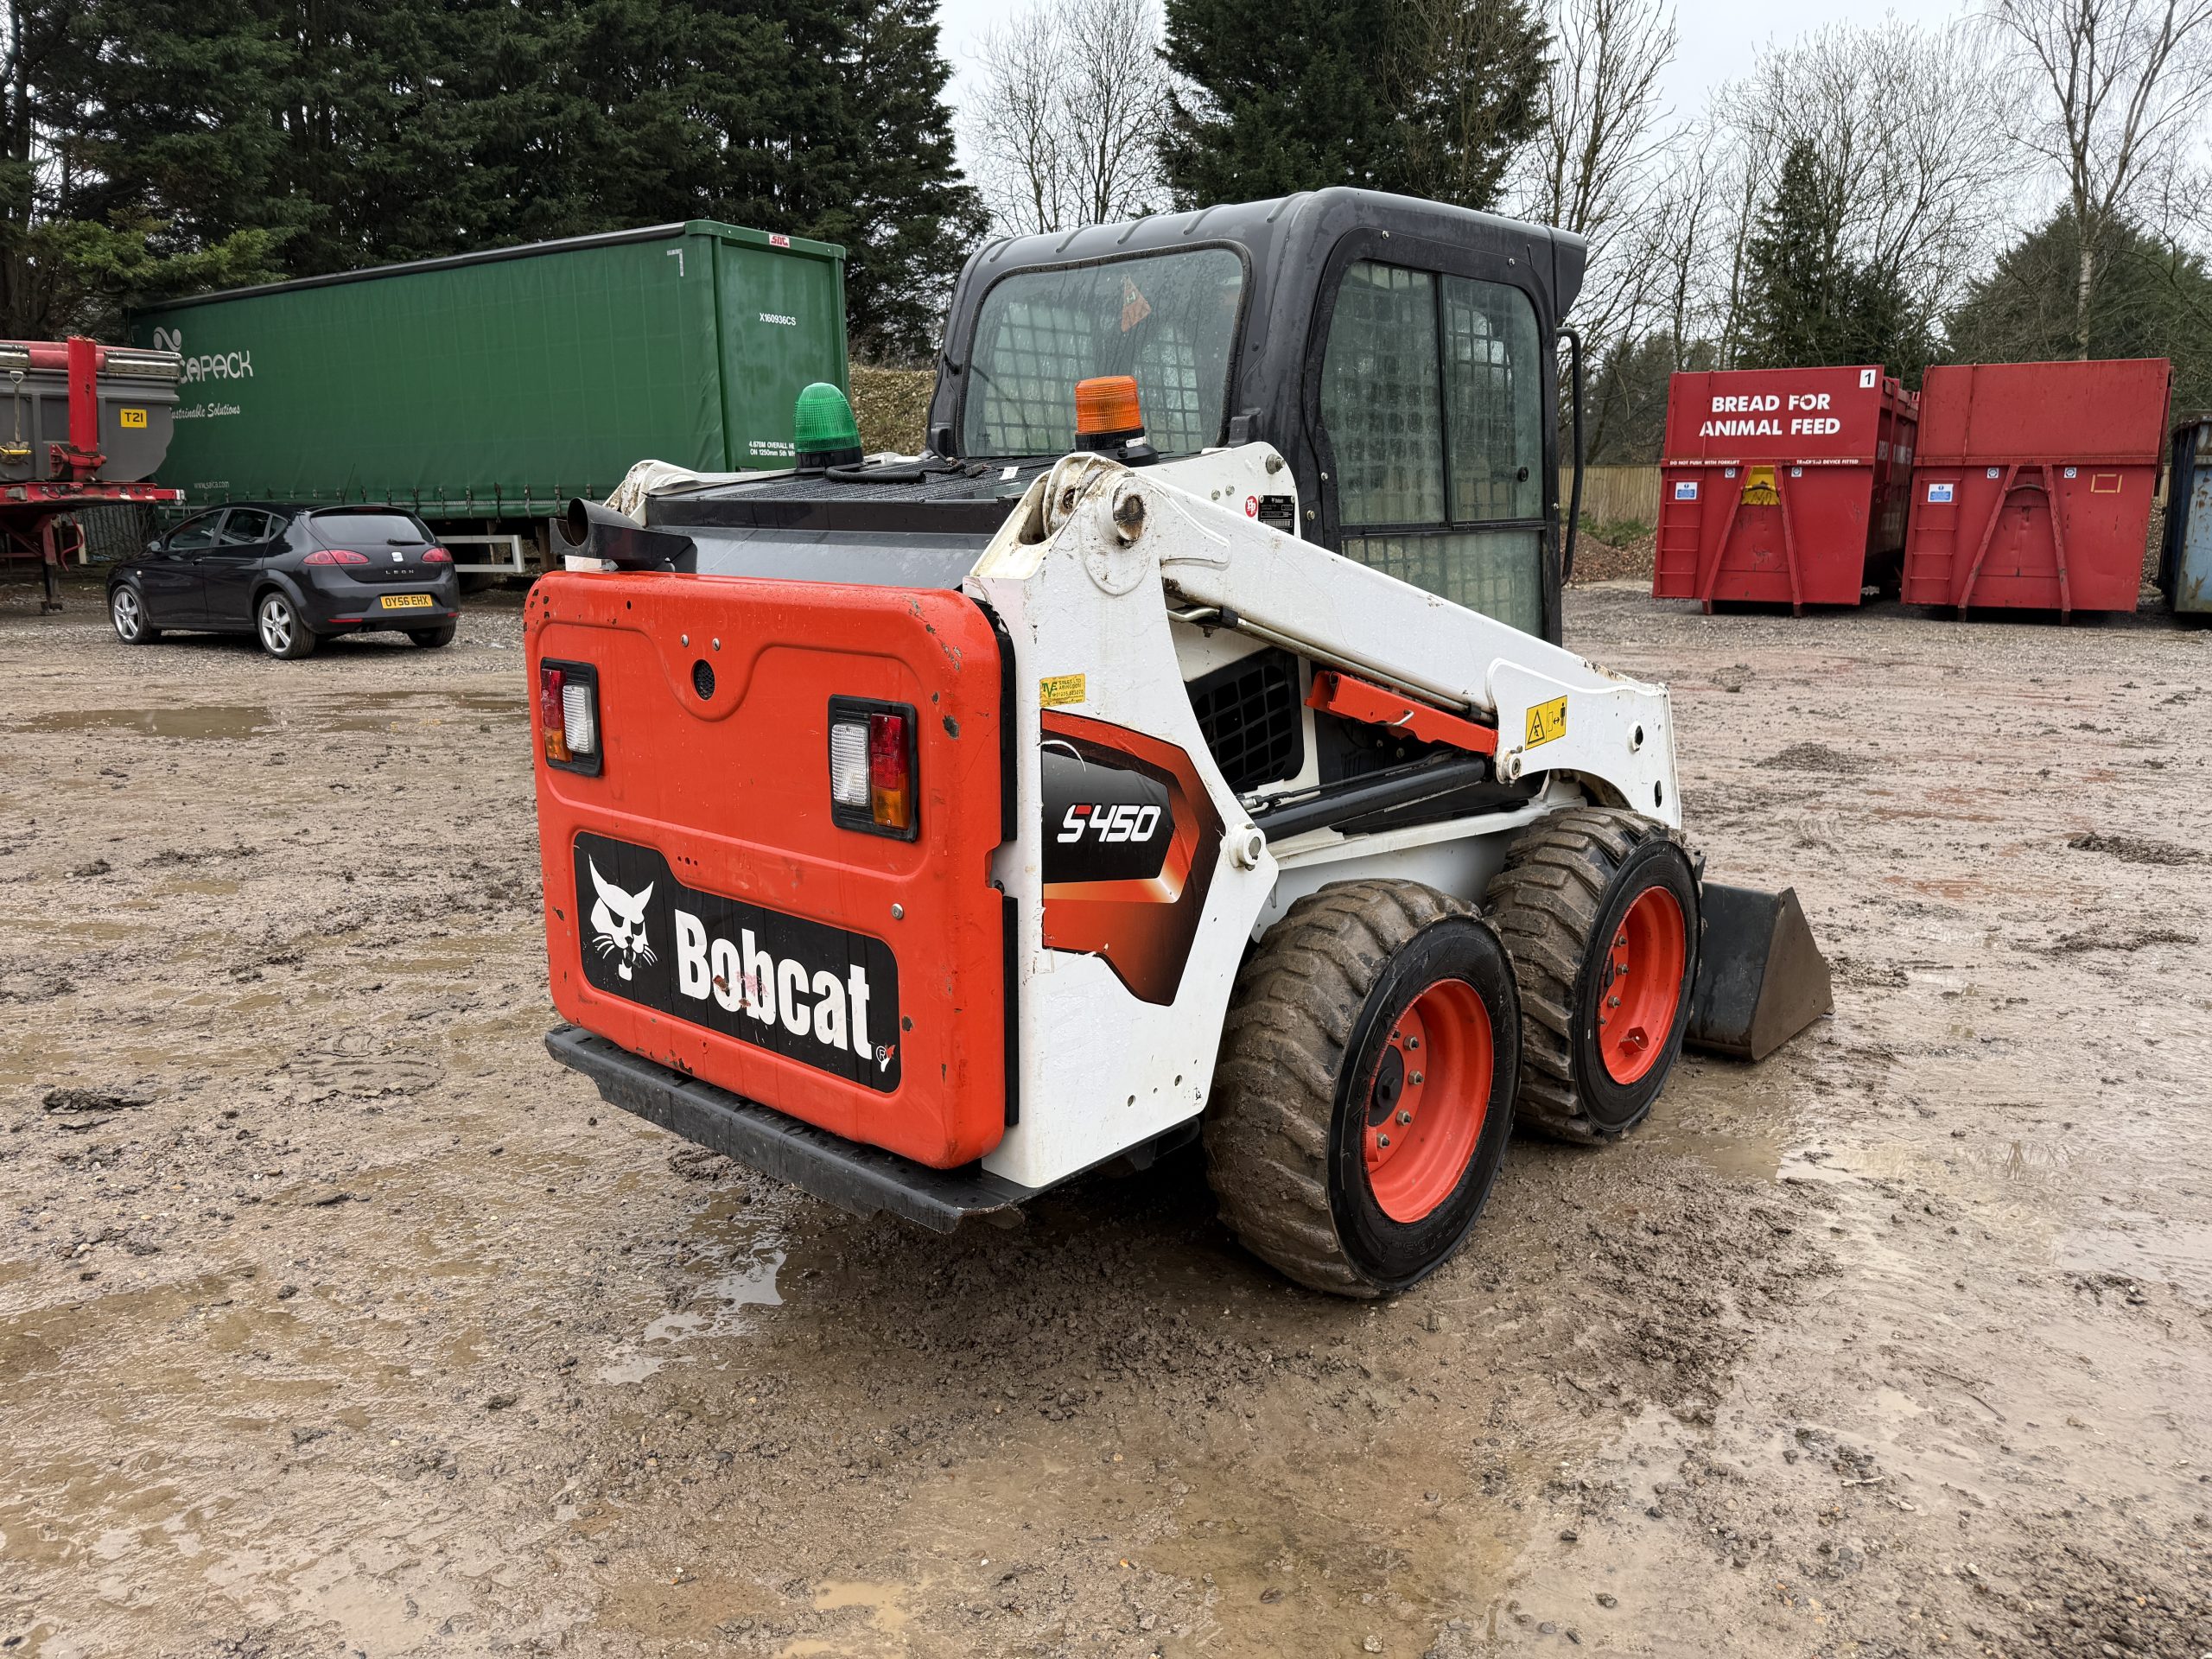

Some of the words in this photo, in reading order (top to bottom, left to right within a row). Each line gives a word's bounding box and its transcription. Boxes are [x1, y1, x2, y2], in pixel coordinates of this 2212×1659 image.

[760, 313, 797, 326] X160936CS
[1865, 372, 1872, 385] 1
[1712, 395, 1780, 412] BREAD
[1788, 393, 1831, 410] FOR
[124, 412, 143, 423] T21
[169, 404, 206, 420] ustainable
[207, 403, 240, 417] Solutions
[1699, 419, 1783, 437] ANIMAL
[1790, 417, 1841, 435] FEED
[410, 596, 429, 606] EHX
[1057, 804, 1161, 843] S450
[674, 908, 872, 1060] Bobcat
